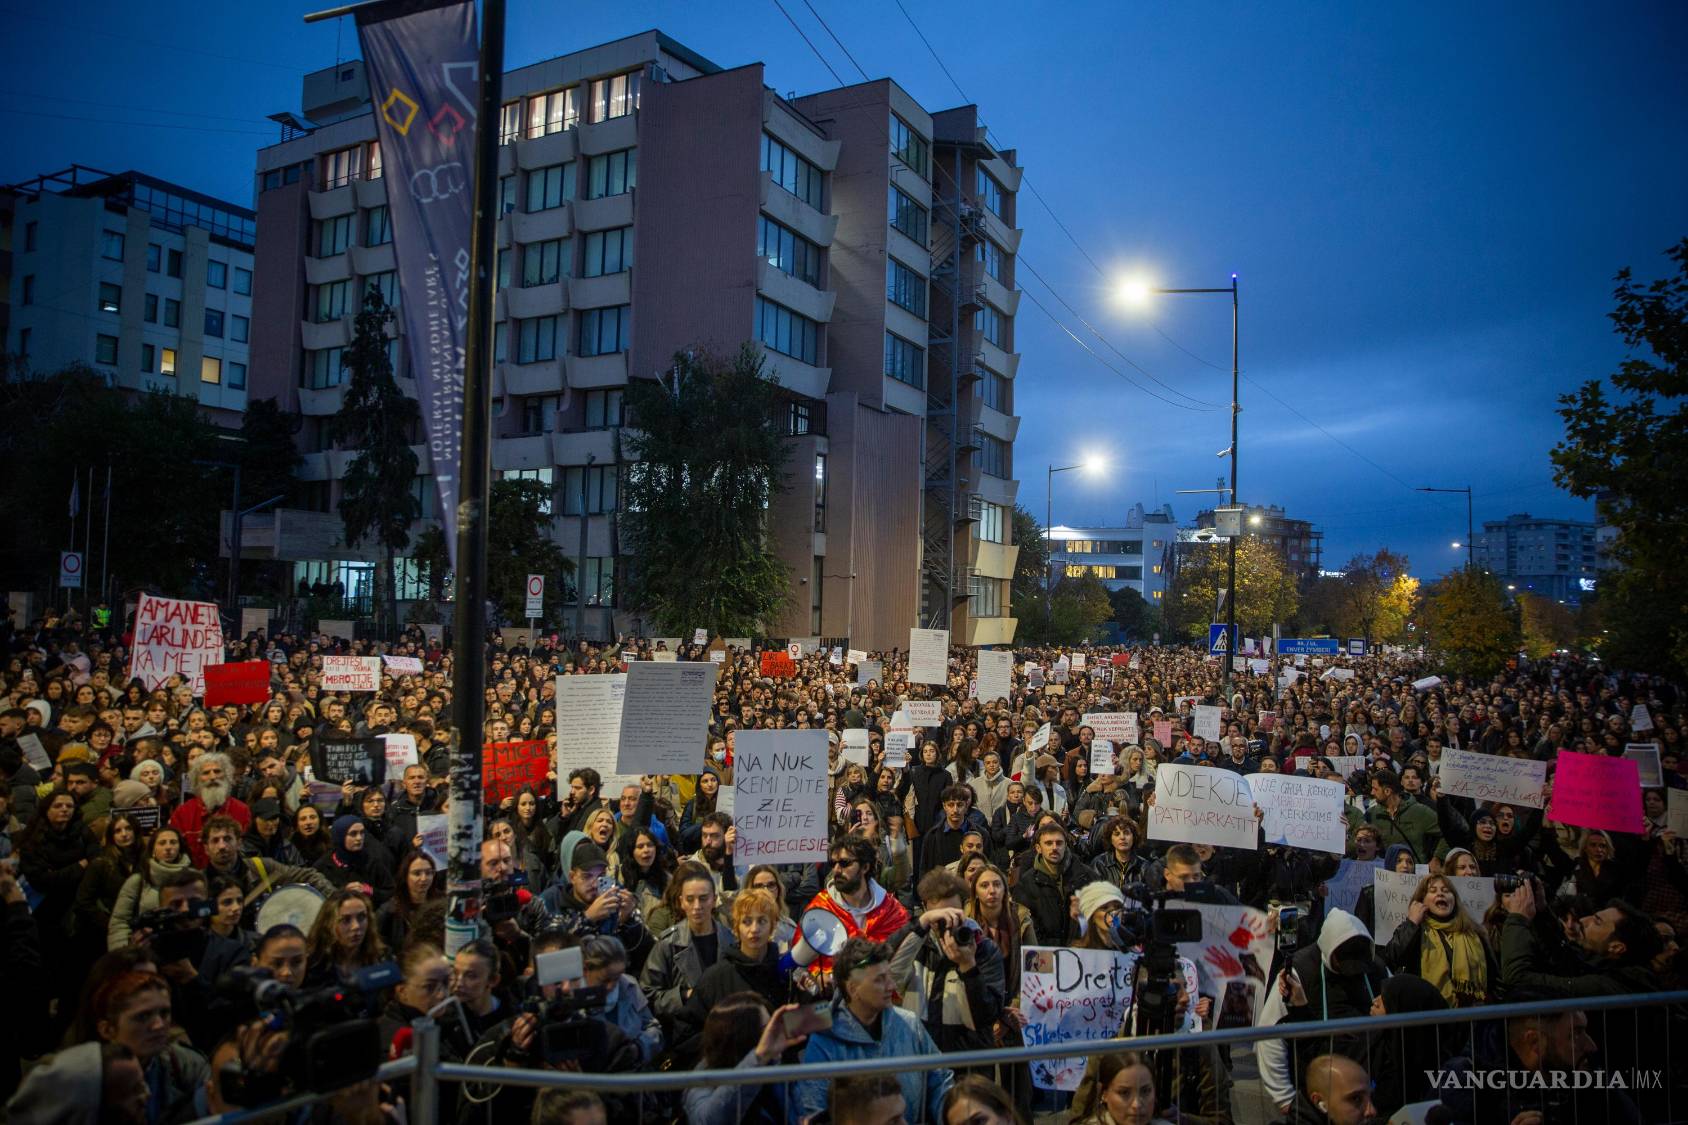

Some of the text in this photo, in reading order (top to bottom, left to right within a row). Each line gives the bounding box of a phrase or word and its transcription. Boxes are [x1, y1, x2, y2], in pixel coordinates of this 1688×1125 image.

[736, 752, 814, 773] NA NUK
[736, 775, 778, 796] KEMI
[1161, 770, 1250, 808] VDEKJE
[735, 814, 773, 832] KEMI
[1154, 805, 1257, 834] PATRIARKATIT
[1053, 948, 1133, 1006] Drejtë
